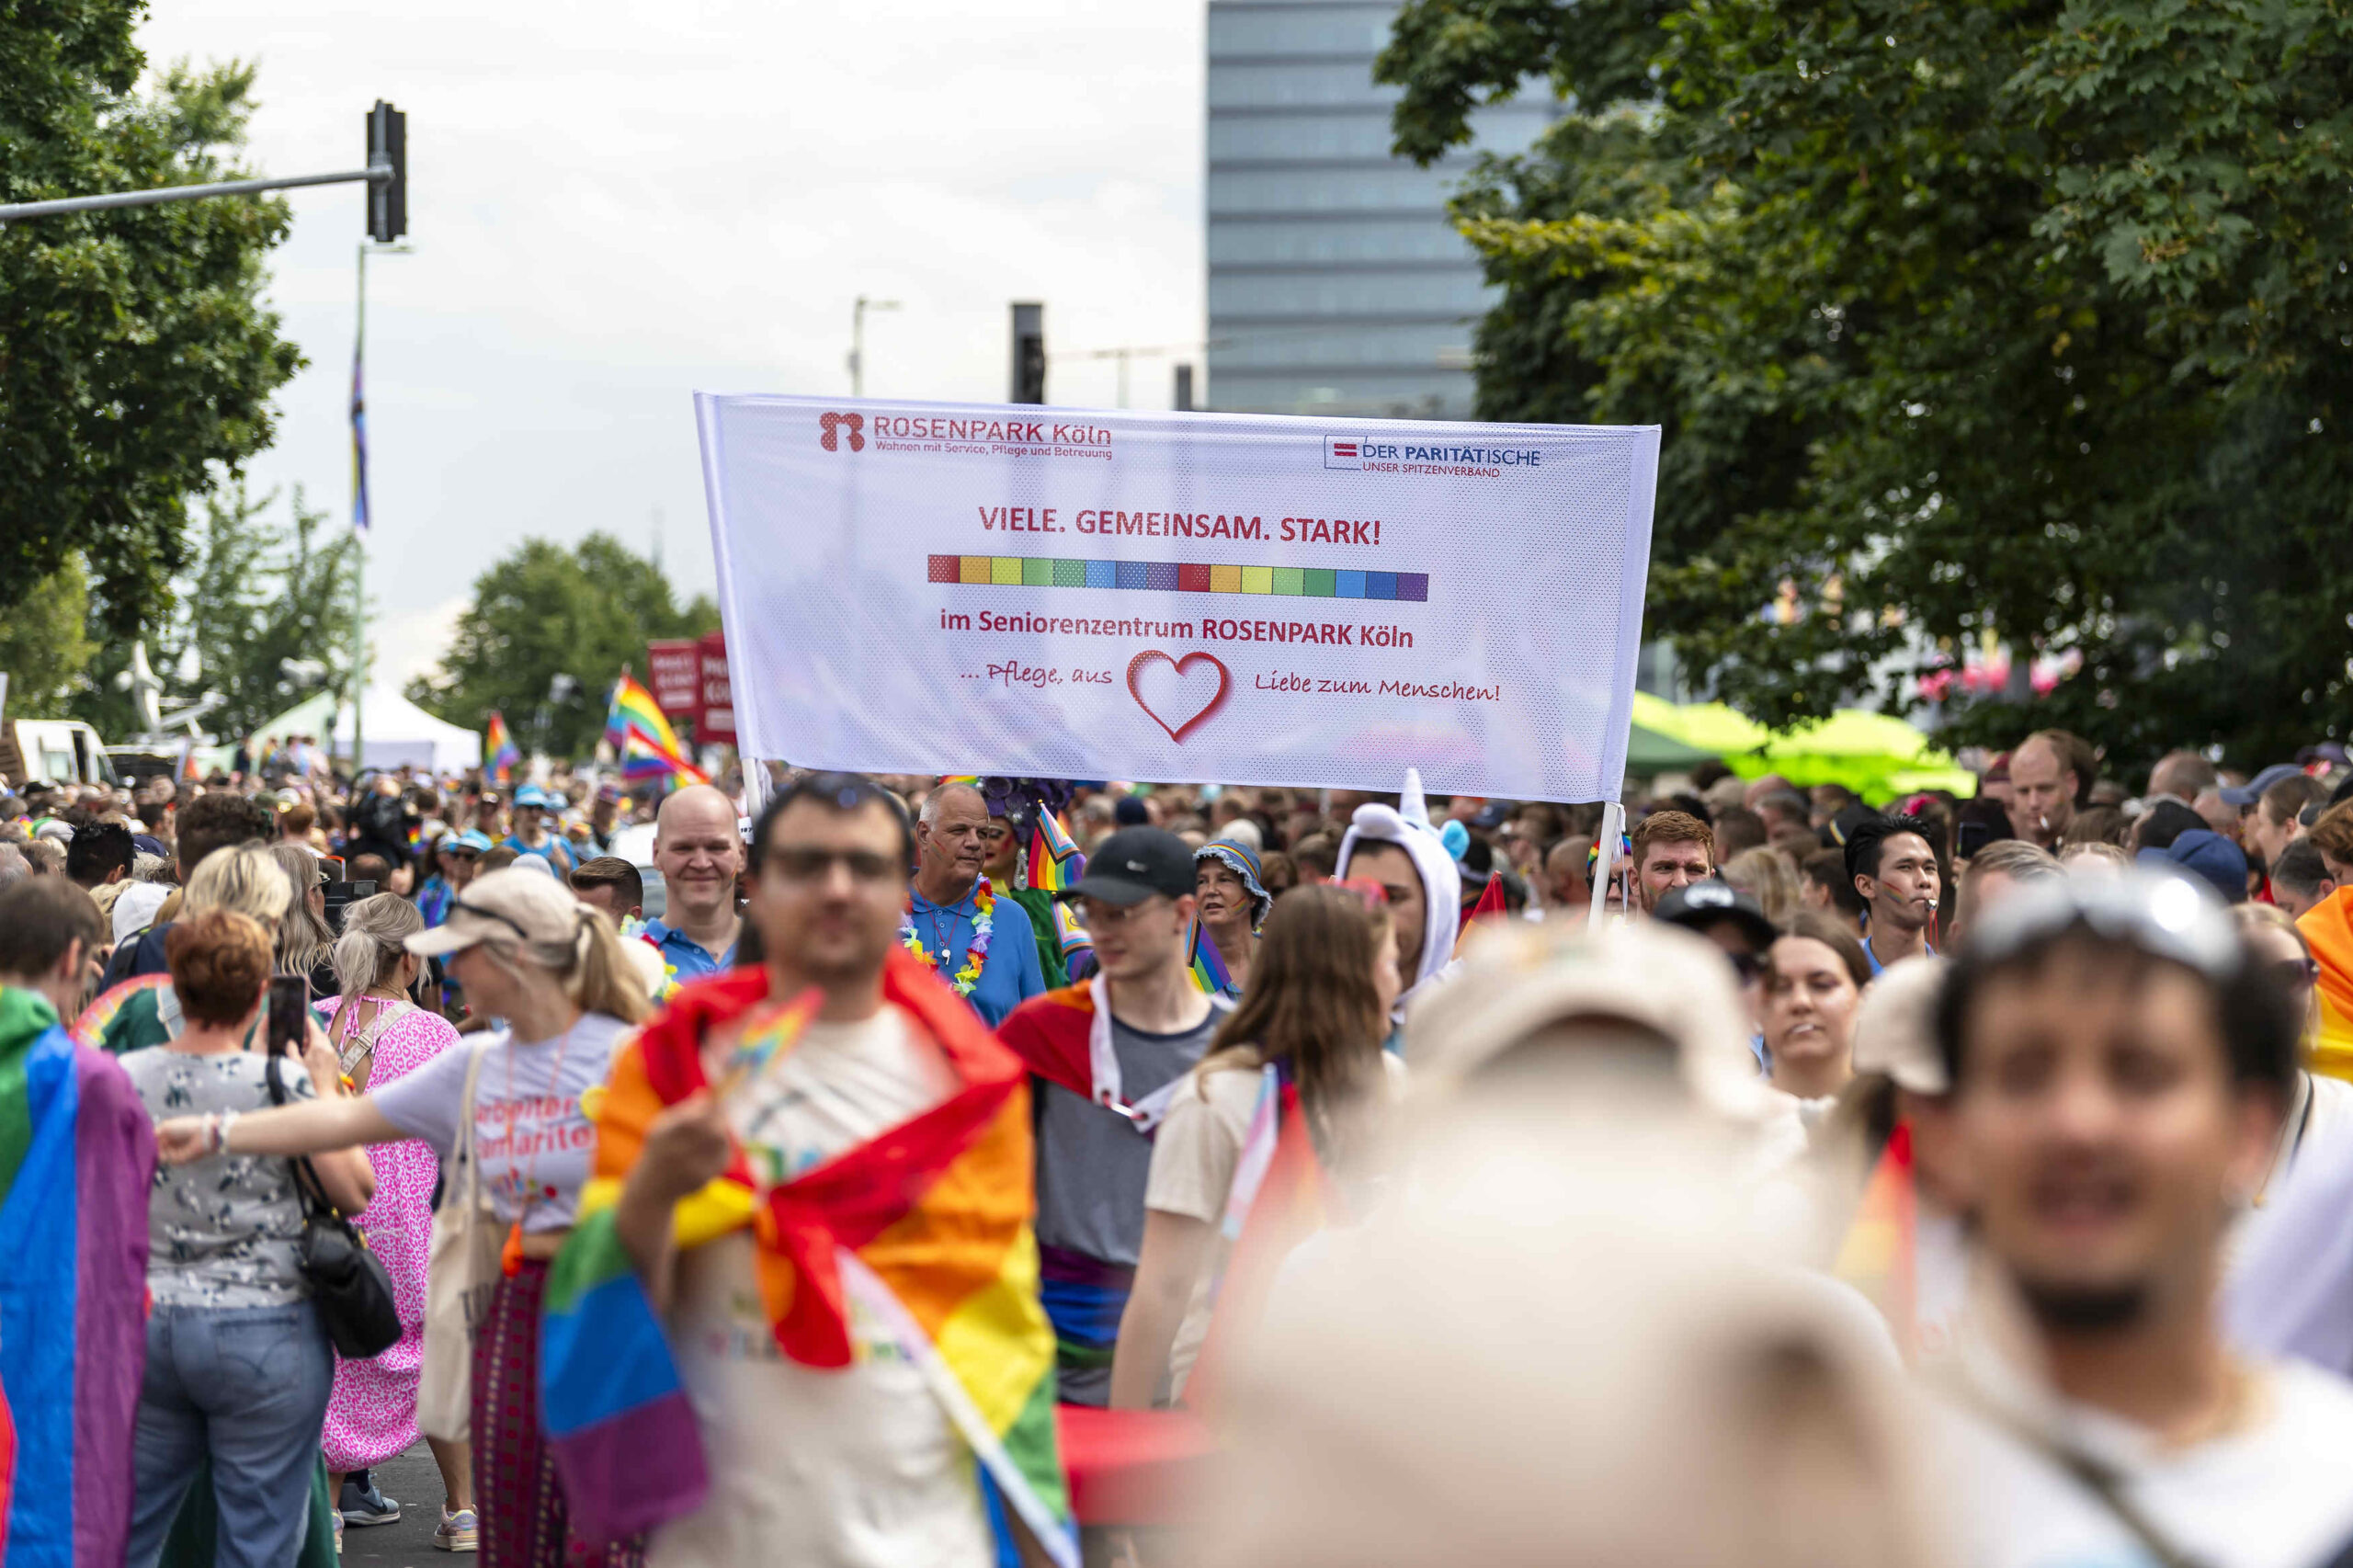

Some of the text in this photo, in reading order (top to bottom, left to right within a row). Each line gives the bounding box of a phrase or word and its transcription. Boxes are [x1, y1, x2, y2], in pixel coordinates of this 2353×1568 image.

[874, 415, 1112, 445] ROSENPARK Köln
[875, 440, 921, 452] Wohnen
[924, 443, 942, 452] mit
[992, 445, 1029, 458] Pflege
[1030, 448, 1051, 456] und
[1054, 447, 1113, 460] Betreuung
[1362, 444, 1541, 466] DER PARITÄTISCHE
[1362, 461, 1501, 478] UNSER SPITZENVERBAND
[979, 506, 1381, 545] VIELE. GEMEINSAM. STARK!
[940, 608, 1414, 648] im Seniorenzentrum ROSENPARK Köln
[986, 660, 1063, 688] Pflege,
[1072, 668, 1112, 684] aus
[1255, 670, 1312, 693] Liebe
[1317, 682, 1371, 694] zum
[1378, 679, 1500, 701] Menschen!
